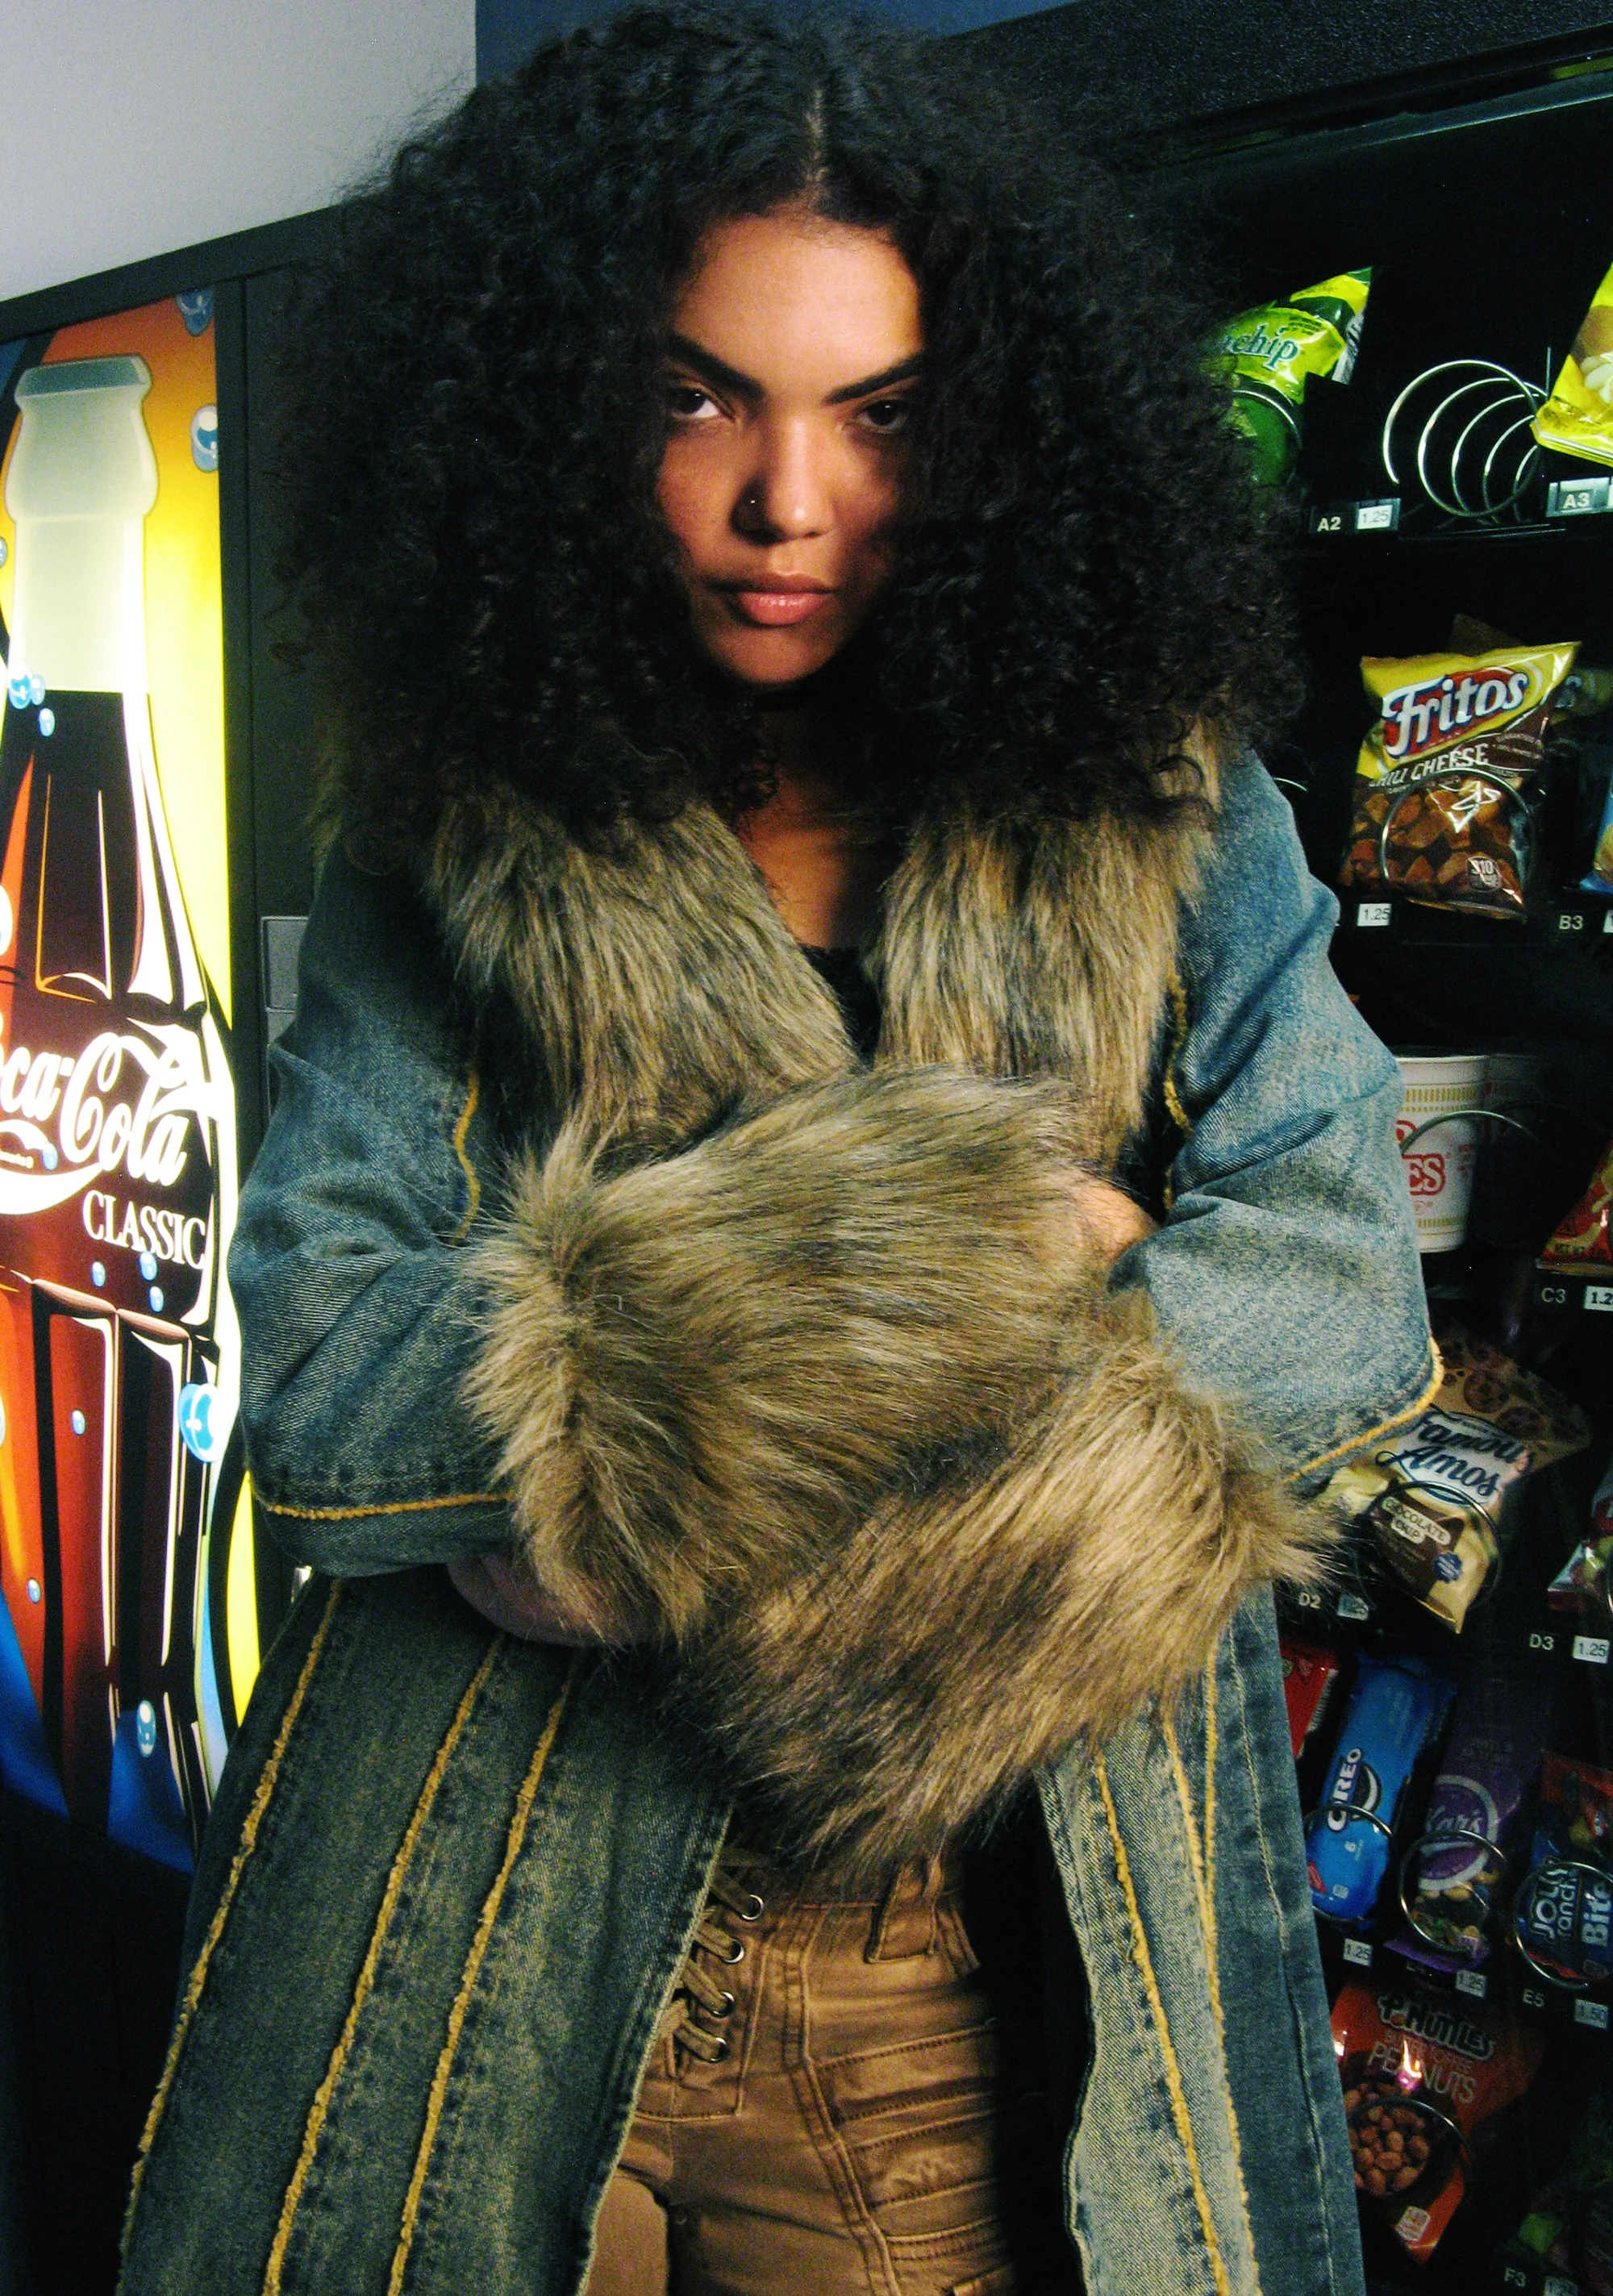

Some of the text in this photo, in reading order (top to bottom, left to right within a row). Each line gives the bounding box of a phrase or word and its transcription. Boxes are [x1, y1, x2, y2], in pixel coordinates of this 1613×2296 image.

[1563, 492, 1590, 509] A3
[1317, 510, 1390, 531] A2 1.25
[1382, 672, 1529, 759] Fritos
[1369, 743, 1490, 787] HILI CHEESE
[1364, 907, 1390, 921] 1.25
[1559, 915, 1584, 930] B3
[83, 1190, 206, 1269] CLASSIC
[1541, 1287, 1613, 1306] C3 1.2
[1375, 1445, 1501, 1496] Amos
[1298, 1593, 1322, 1609] D2
[1529, 1633, 1607, 1657] D3 1.25
[1327, 1748, 1362, 1831] OREO
[1522, 1988, 1544, 2008] E5
[1366, 2040, 1478, 2104] PENUTS
